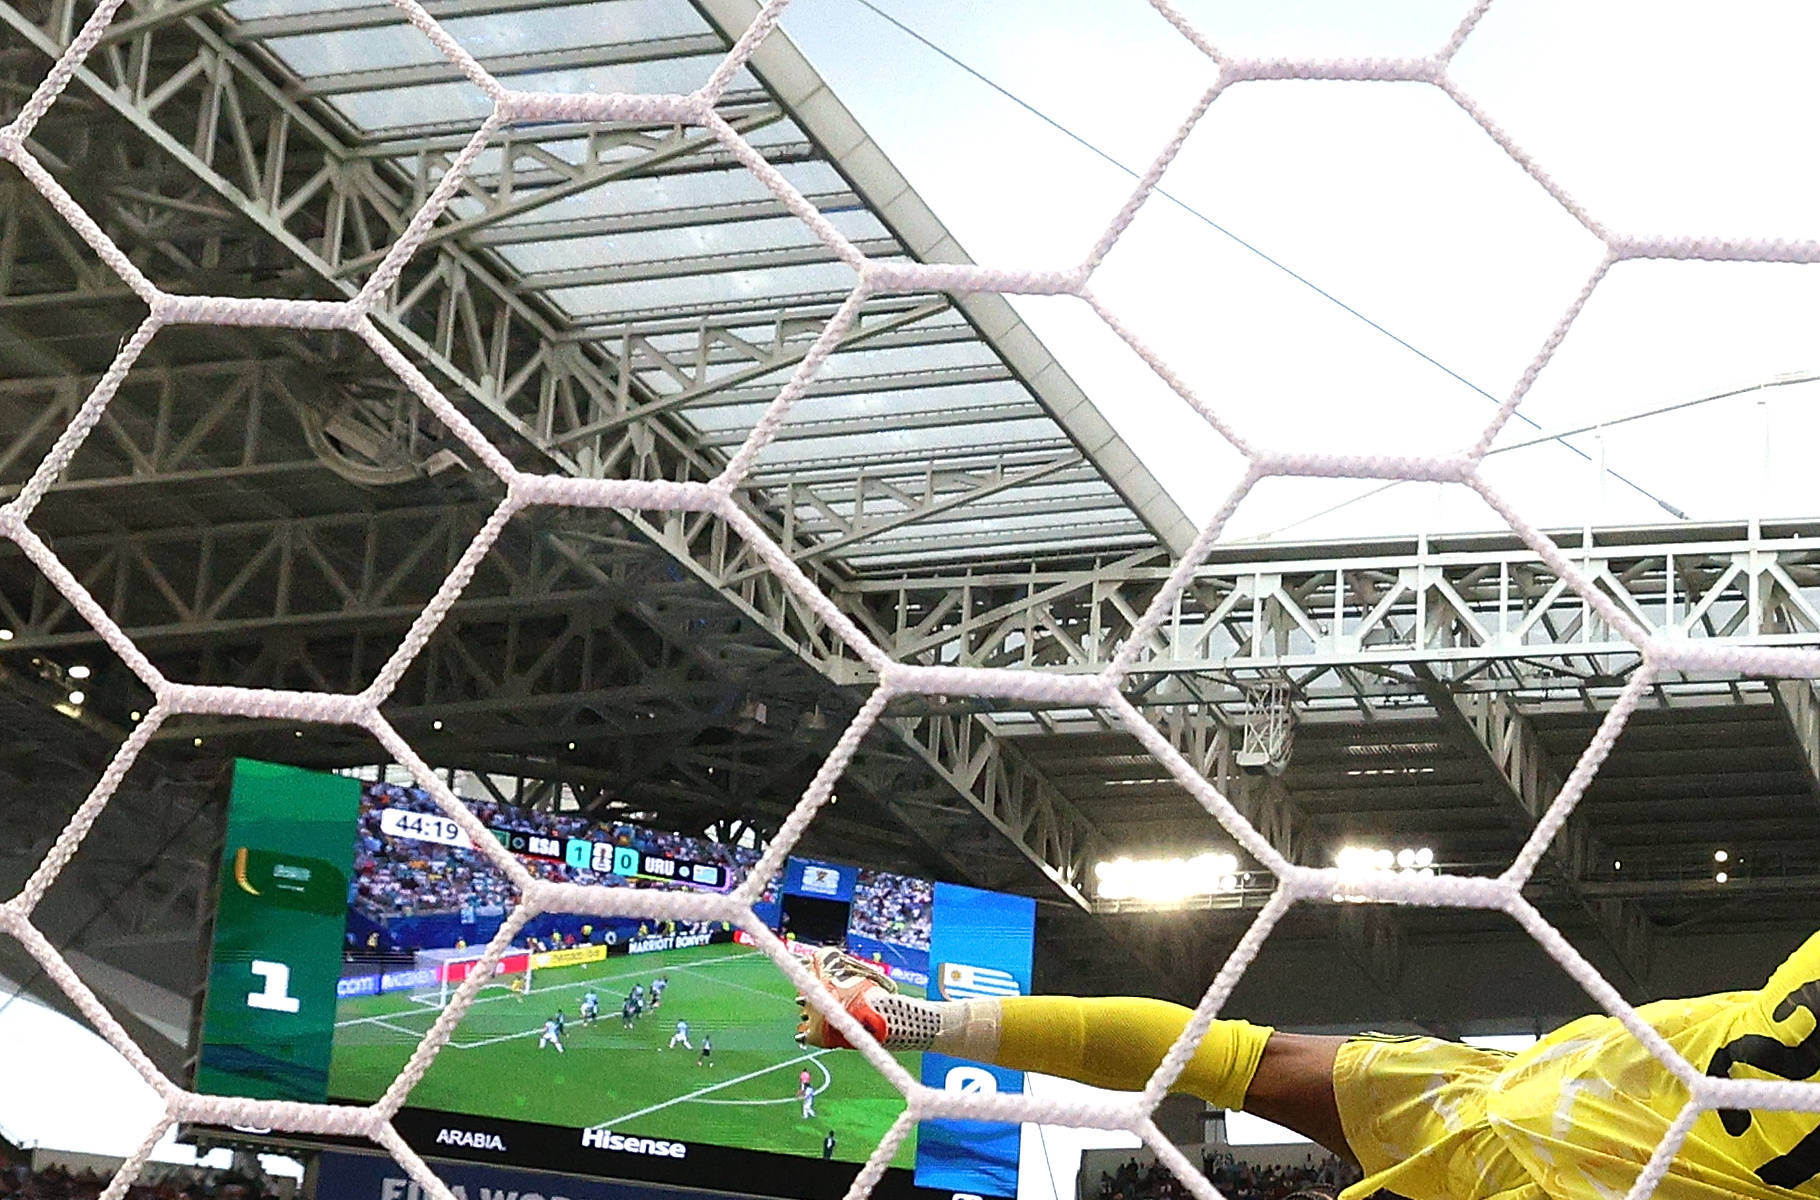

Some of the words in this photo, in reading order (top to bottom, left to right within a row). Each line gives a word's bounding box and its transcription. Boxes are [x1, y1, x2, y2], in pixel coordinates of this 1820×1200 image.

[395, 815, 459, 841] 44:19
[528, 836, 560, 857] KSA
[621, 855, 631, 869] 0
[645, 856, 675, 876] URU
[247, 959, 299, 1013] 1
[582, 1128, 687, 1158] Hisense
